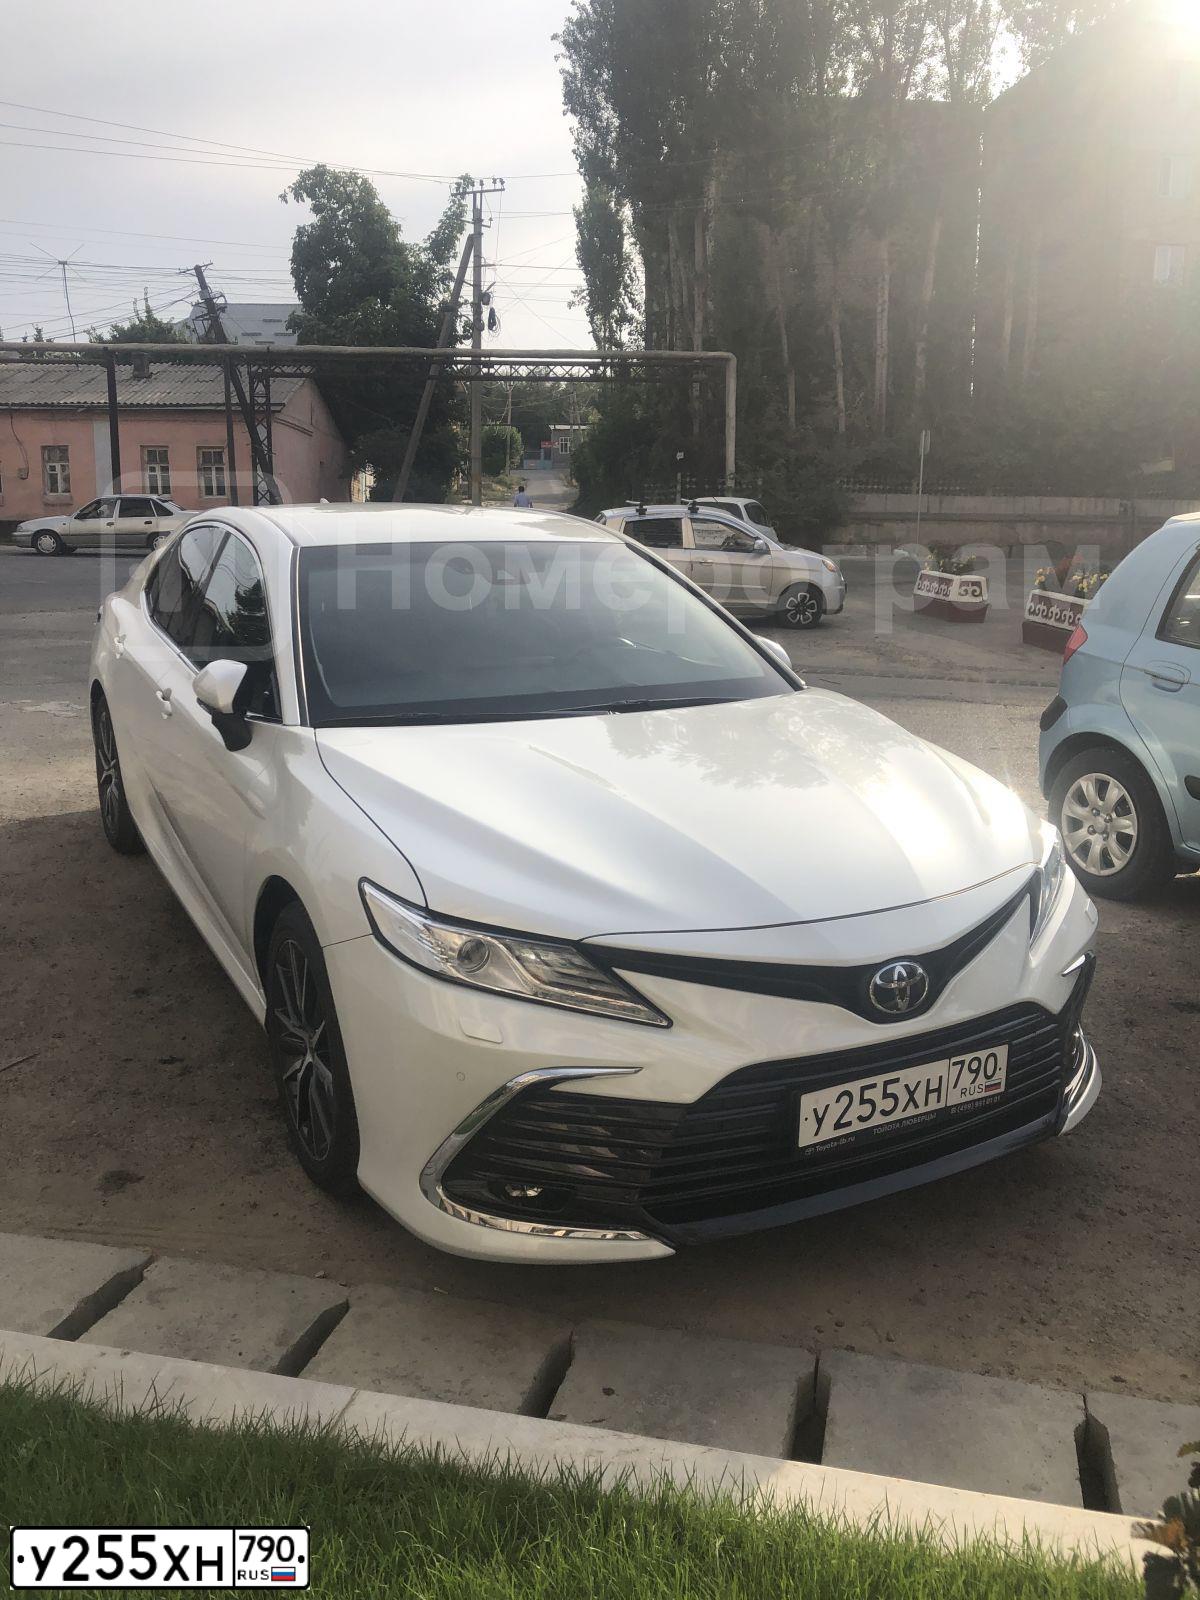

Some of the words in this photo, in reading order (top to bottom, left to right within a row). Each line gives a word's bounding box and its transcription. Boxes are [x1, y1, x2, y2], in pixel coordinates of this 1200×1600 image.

[951, 1052, 998, 1090] 790
[812, 1075, 944, 1137] У255ХН
[960, 1083, 984, 1099] RUS
